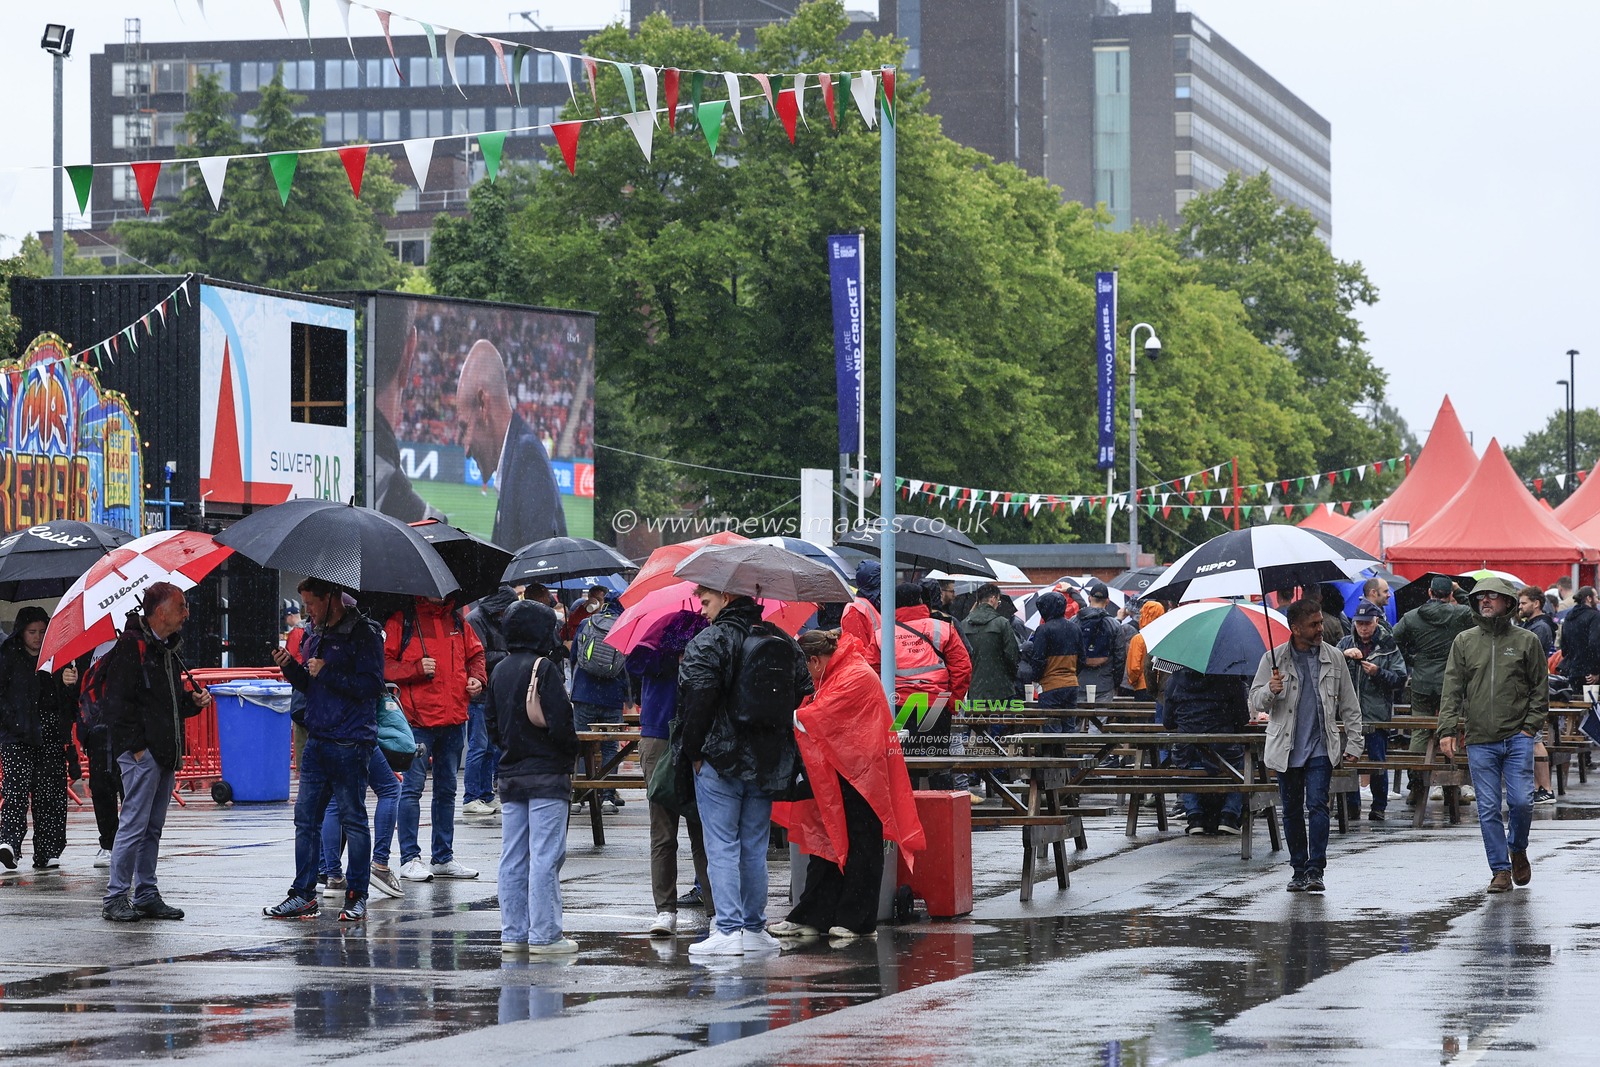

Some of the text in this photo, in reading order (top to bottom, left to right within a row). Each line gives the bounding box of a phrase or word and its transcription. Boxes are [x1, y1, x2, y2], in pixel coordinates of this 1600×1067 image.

[847, 277, 860, 344] CRICKET
[1102, 303, 1112, 351] ASHES.
[843, 330, 853, 372] WE ARE
[0, 452, 90, 534] KEBAB
[270, 451, 341, 502] SILVER BAR
[98, 574, 150, 609] Wilson
